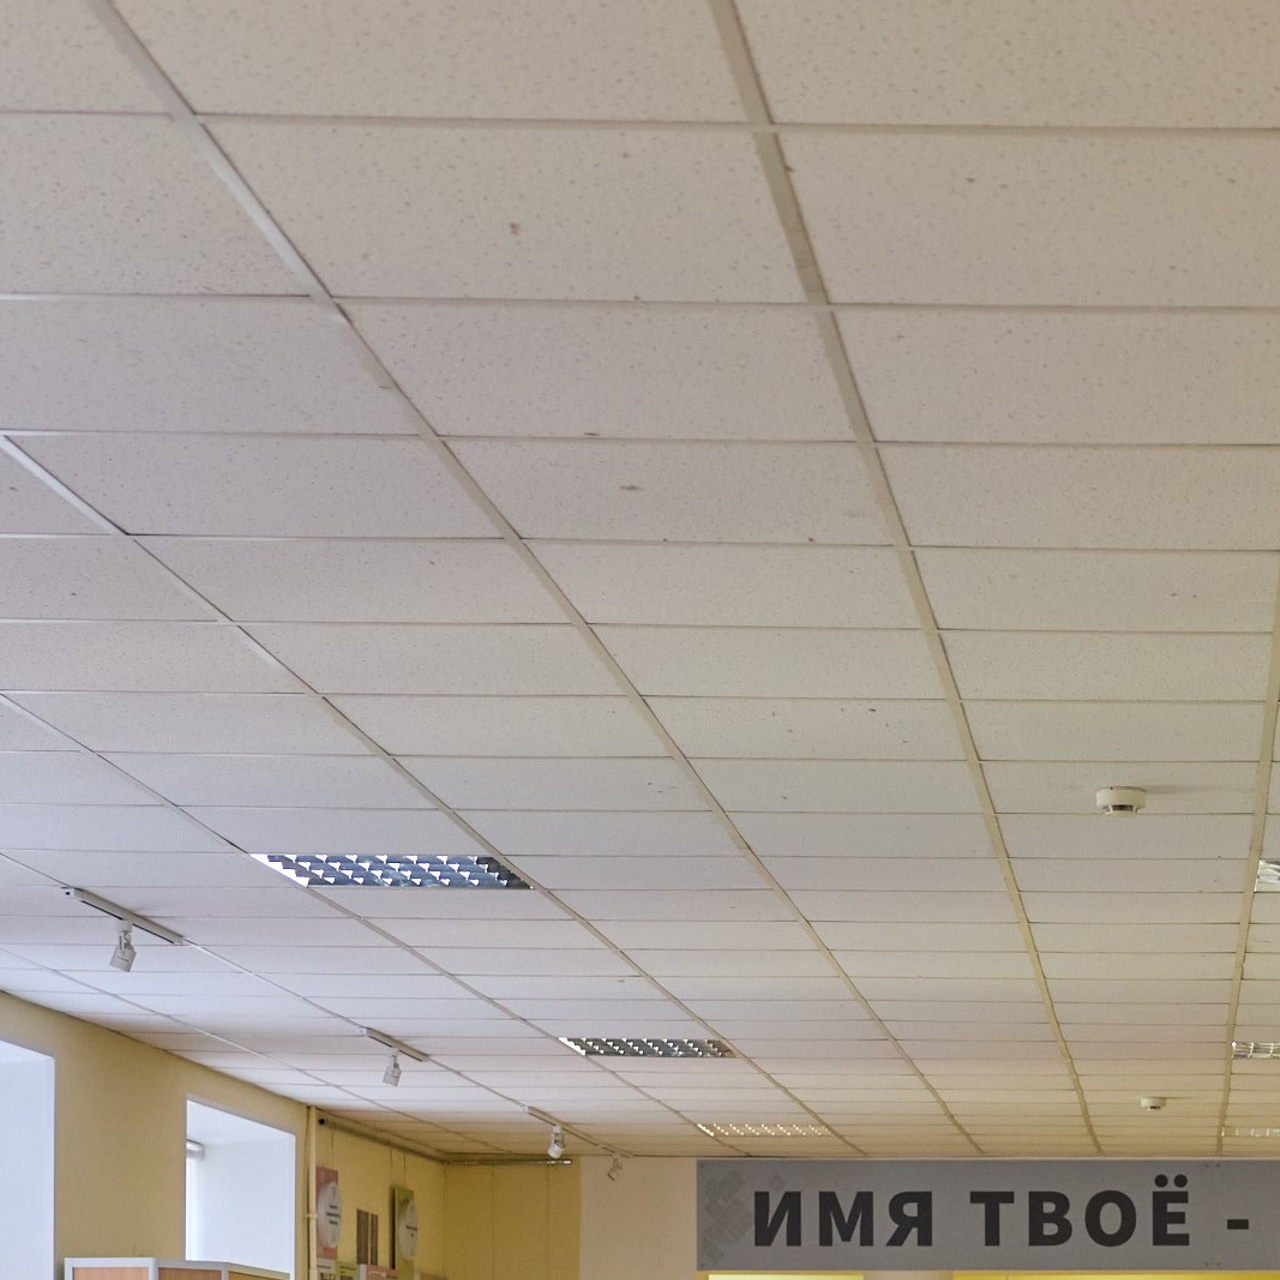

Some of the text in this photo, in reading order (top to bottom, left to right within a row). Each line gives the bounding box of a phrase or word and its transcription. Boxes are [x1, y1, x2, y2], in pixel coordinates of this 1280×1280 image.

[754, 1190, 933, 1247] ИМЯ
[970, 1174, 1190, 1247] ТВОЁ
[1226, 1218, 1250, 1231] -
